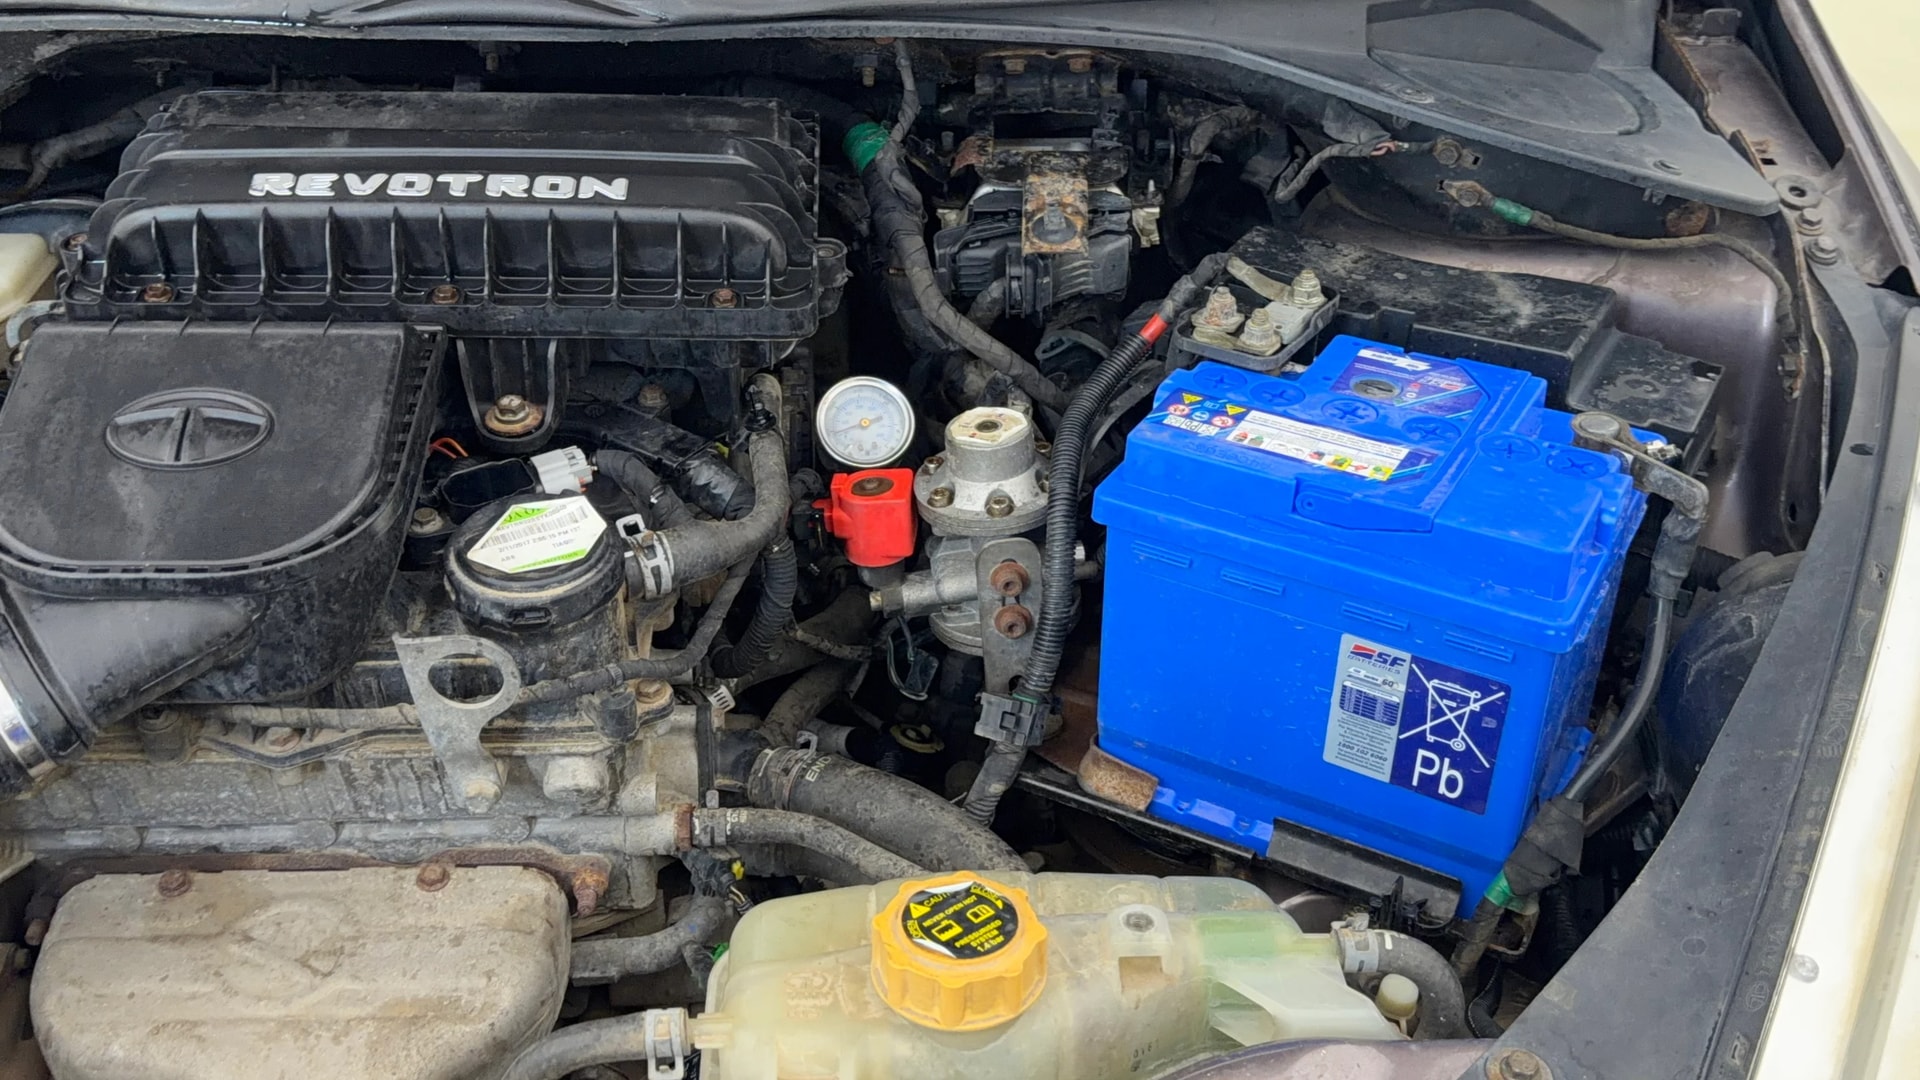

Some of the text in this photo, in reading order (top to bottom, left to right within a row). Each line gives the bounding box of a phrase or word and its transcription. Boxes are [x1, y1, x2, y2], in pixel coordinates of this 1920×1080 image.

[247, 172, 629, 200] REVOTRON
[1374, 651, 1406, 667] SF
[805, 756, 831, 782] END
[1411, 748, 1464, 799] Pb
